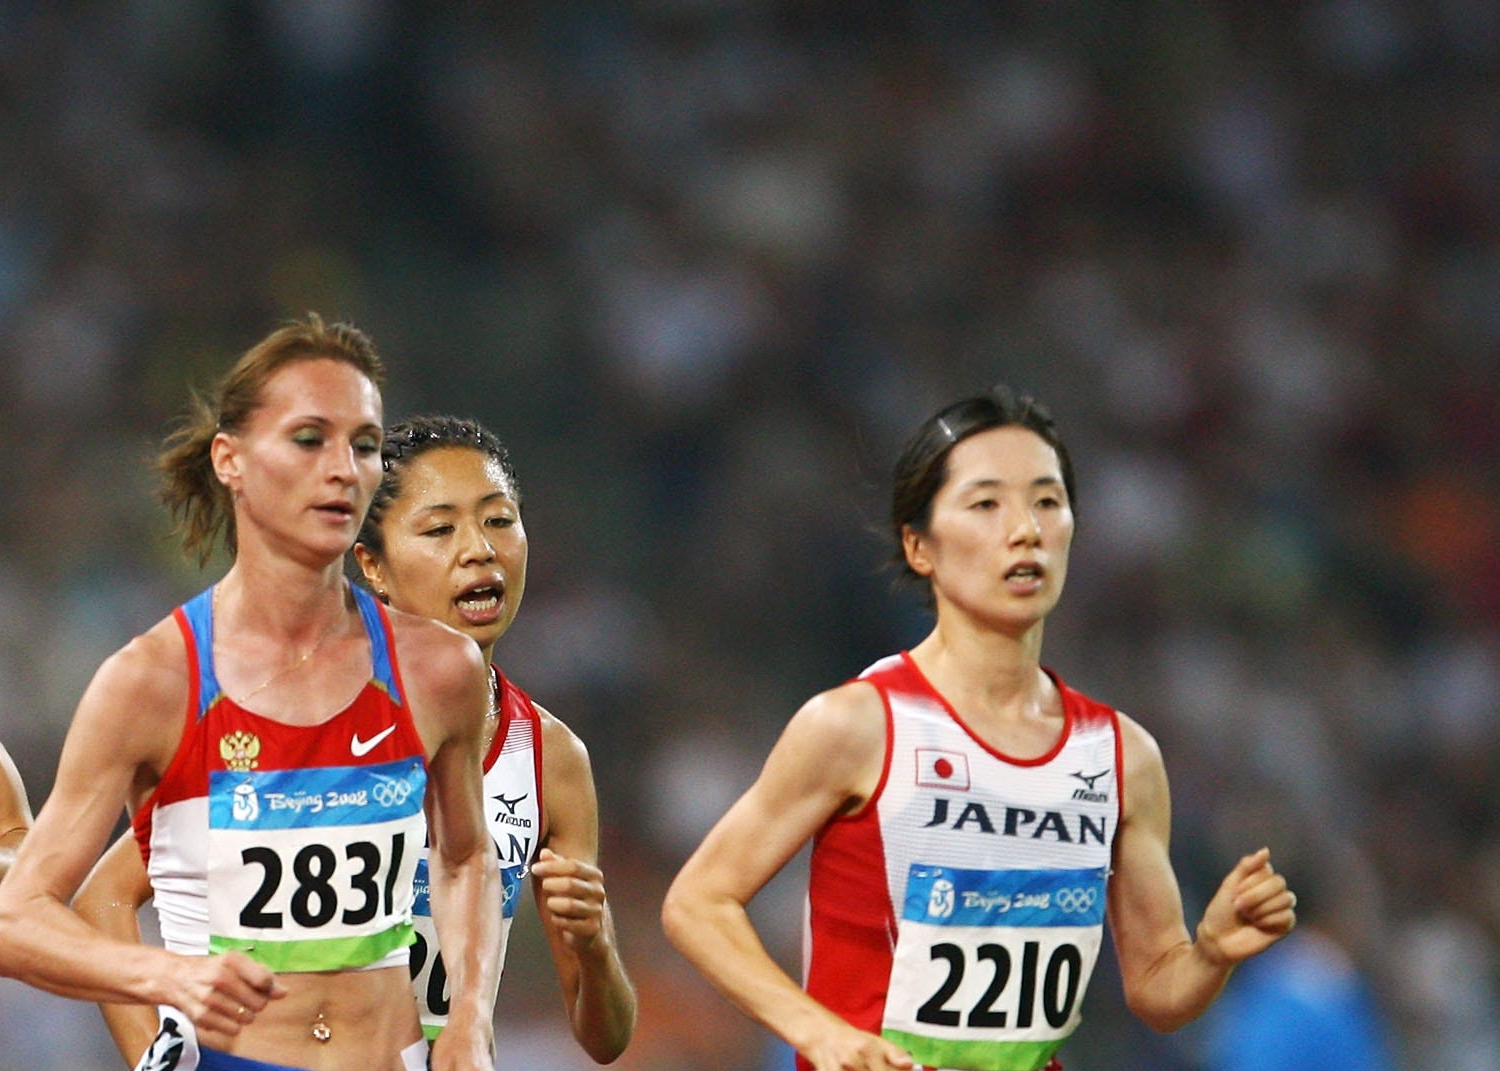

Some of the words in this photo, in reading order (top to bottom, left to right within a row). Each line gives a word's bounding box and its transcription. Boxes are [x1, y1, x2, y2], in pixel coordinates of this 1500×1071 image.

[264, 791, 324, 813] Beijing
[326, 790, 368, 807] 2008
[919, 798, 1107, 846] JAPAN
[239, 832, 405, 929] 2831
[961, 890, 1011, 913] Beijing
[1012, 892, 1051, 909] 2008
[916, 941, 1082, 1029] 2210
